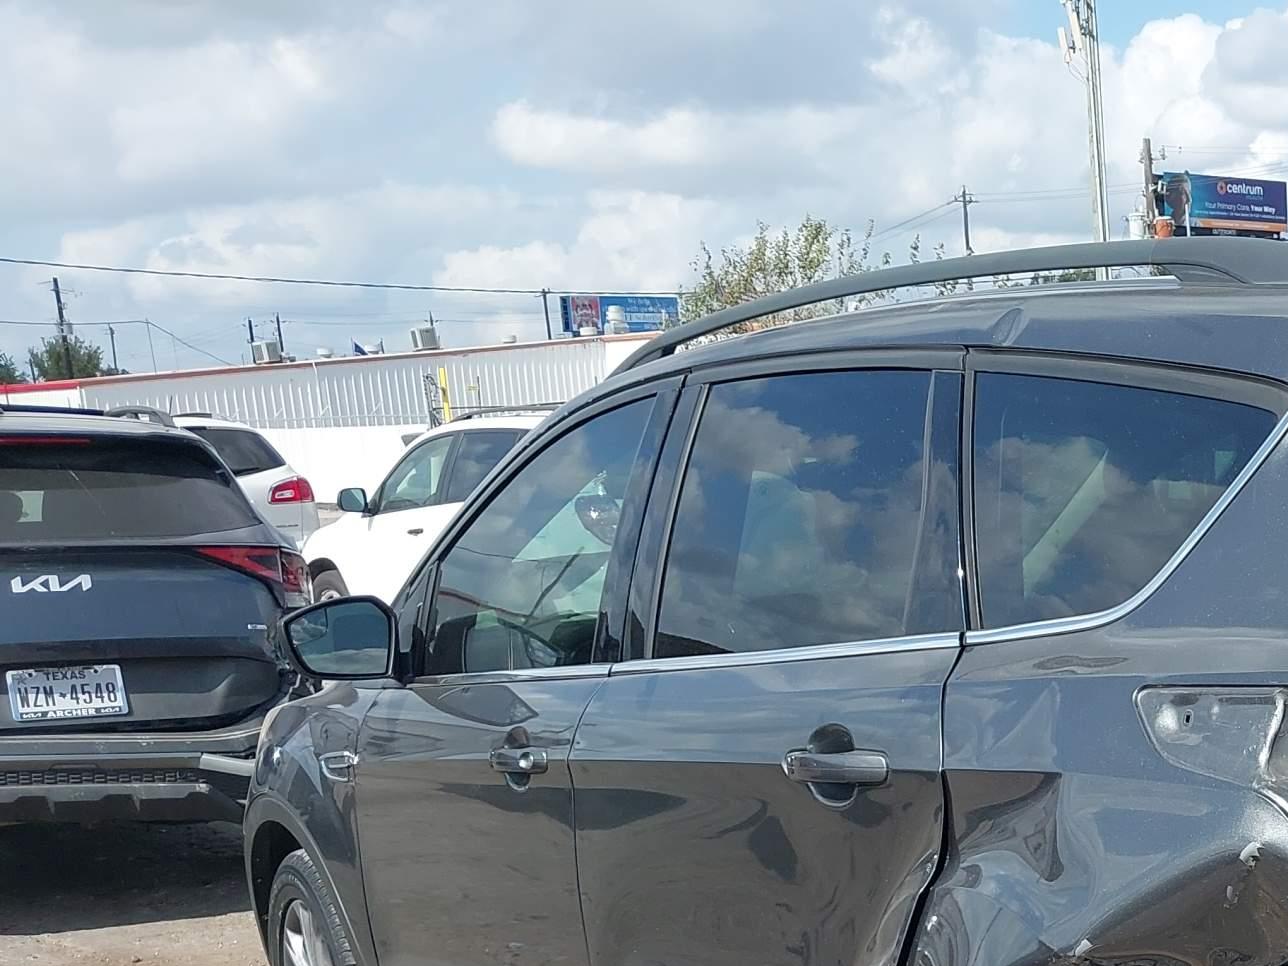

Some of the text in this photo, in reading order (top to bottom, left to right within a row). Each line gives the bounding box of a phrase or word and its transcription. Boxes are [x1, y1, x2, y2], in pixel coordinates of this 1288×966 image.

[1226, 183, 1263, 195] centrum
[1217, 202, 1236, 211] Primary
[11, 574, 92, 593] KIA
[43, 671, 87, 681] TEXAS
[46, 708, 97, 718] ARCHER
